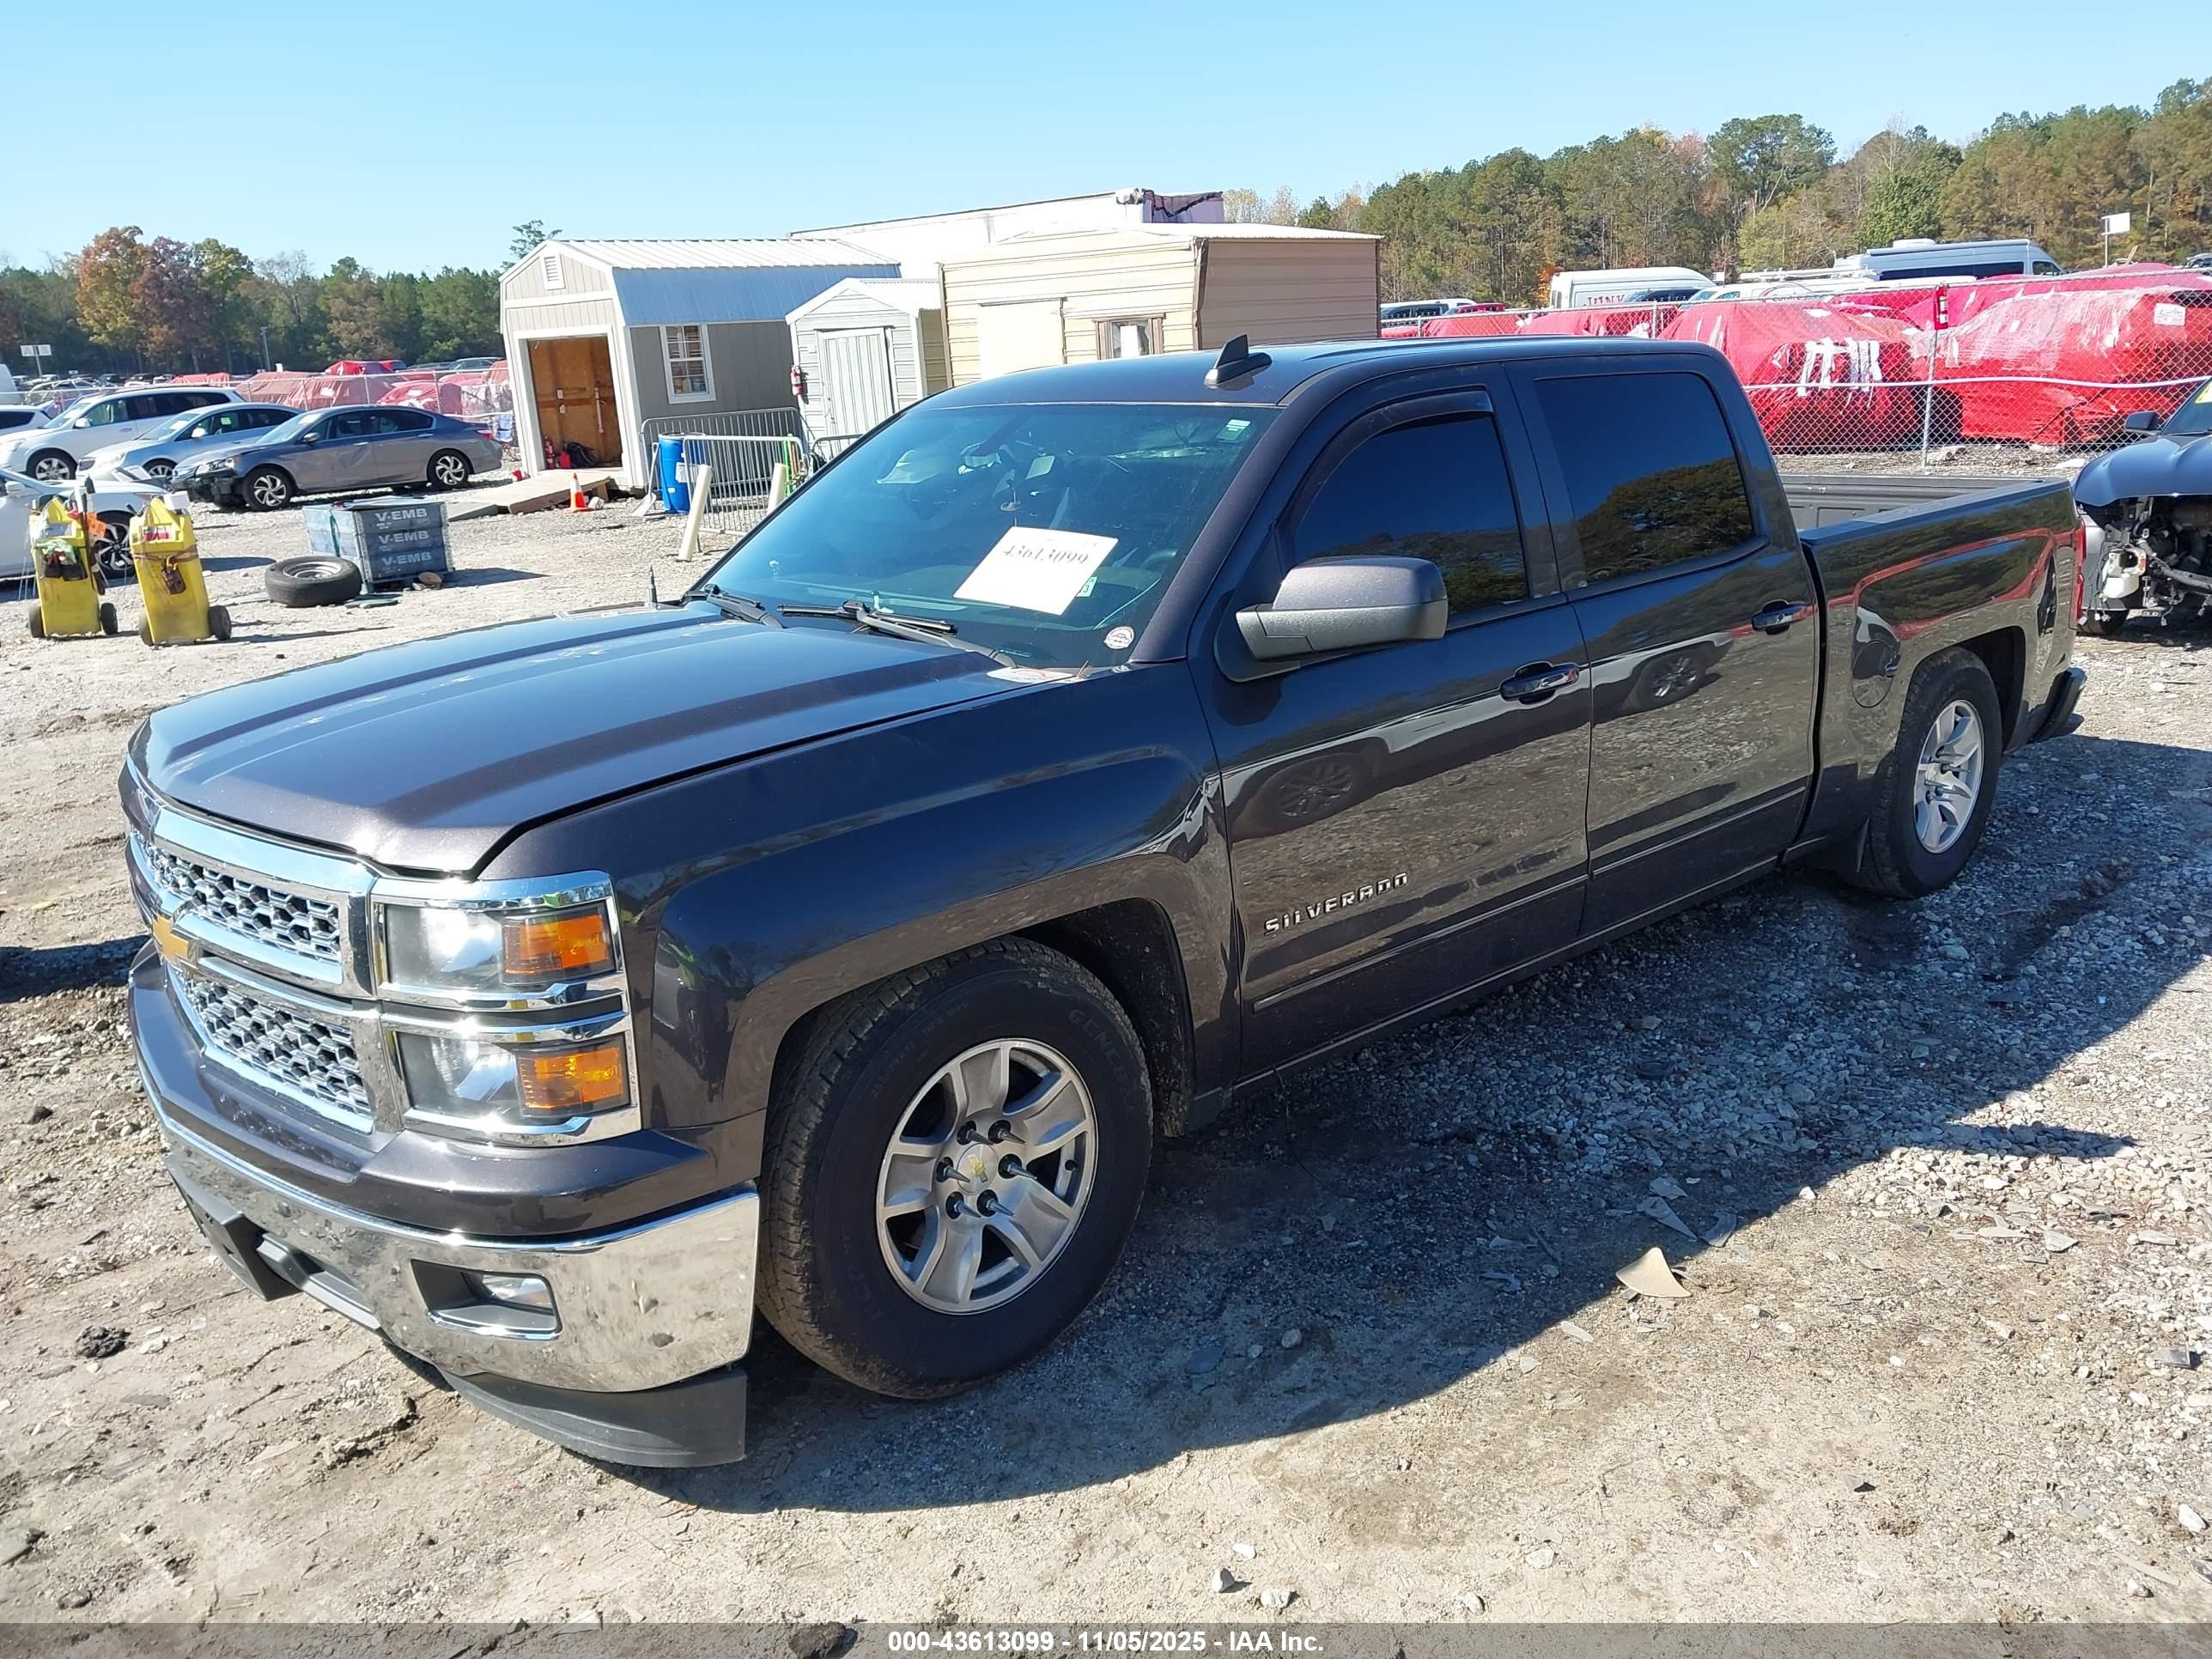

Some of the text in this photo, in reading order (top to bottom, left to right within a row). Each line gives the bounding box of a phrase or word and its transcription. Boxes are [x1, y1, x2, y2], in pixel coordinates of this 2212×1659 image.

[375, 508, 428, 522] V-EMB
[379, 531, 429, 544] V-EMB
[382, 552, 432, 566] V-EMB
[1003, 544, 1089, 564] 43613099
[1264, 872, 1408, 936] SILVERADO
[1066, 1008, 1133, 1115] GENER
